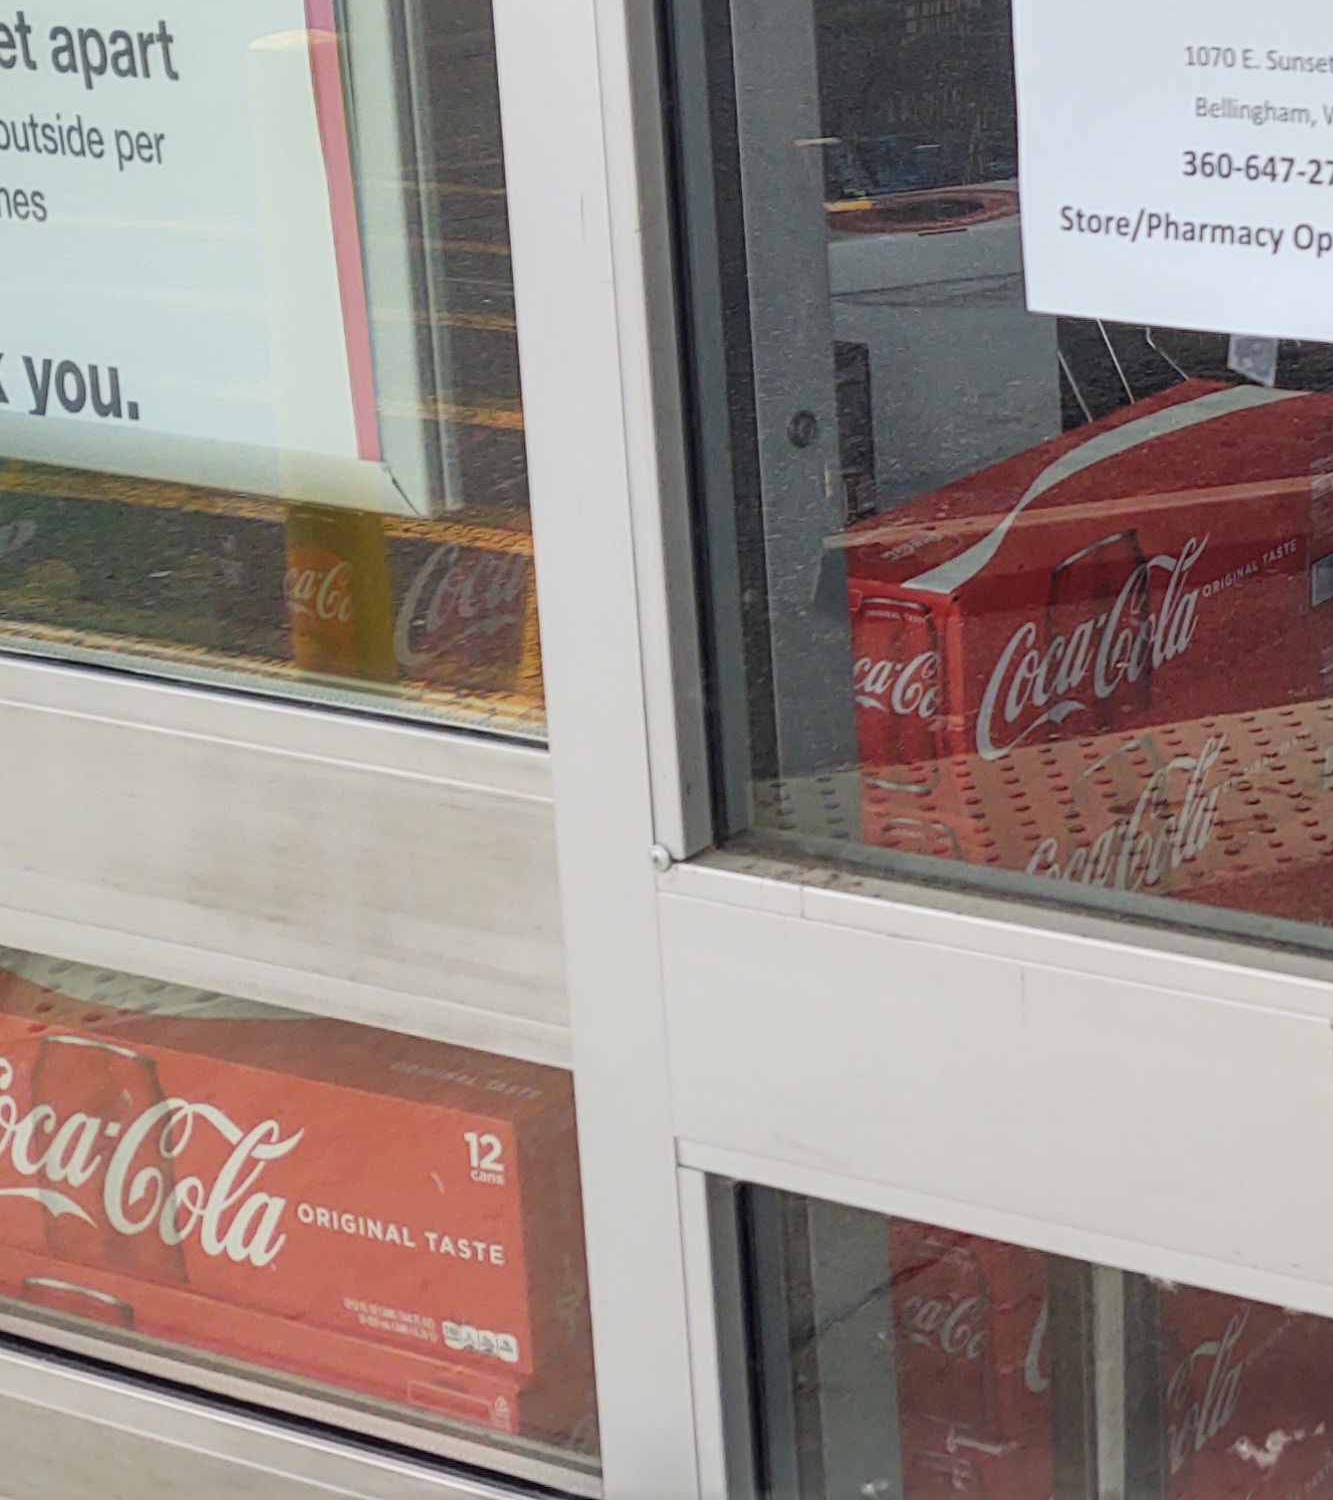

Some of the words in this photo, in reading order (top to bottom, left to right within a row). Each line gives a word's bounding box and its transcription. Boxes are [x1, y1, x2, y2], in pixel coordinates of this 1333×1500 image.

[50, 20, 179, 90] apart
[1184, 46, 1236, 69] 1070
[1241, 49, 1260, 70] E.
[1195, 98, 1317, 128] Bellingham,
[115, 130, 165, 171] per
[1060, 205, 1284, 257] Store/Pharmacy
[23, 355, 140, 421] you.
[1202, 564, 1258, 598] ORIGINAL
[1262, 539, 1297, 566] TASTE
[976, 532, 1210, 763] Coca-Cola
[0, 1056, 305, 1267] oca-Cola
[464, 1132, 504, 1171] 12
[470, 1168, 505, 1186] cans
[298, 1202, 416, 1248] ORIGINAL
[425, 1231, 505, 1265] TASTE
